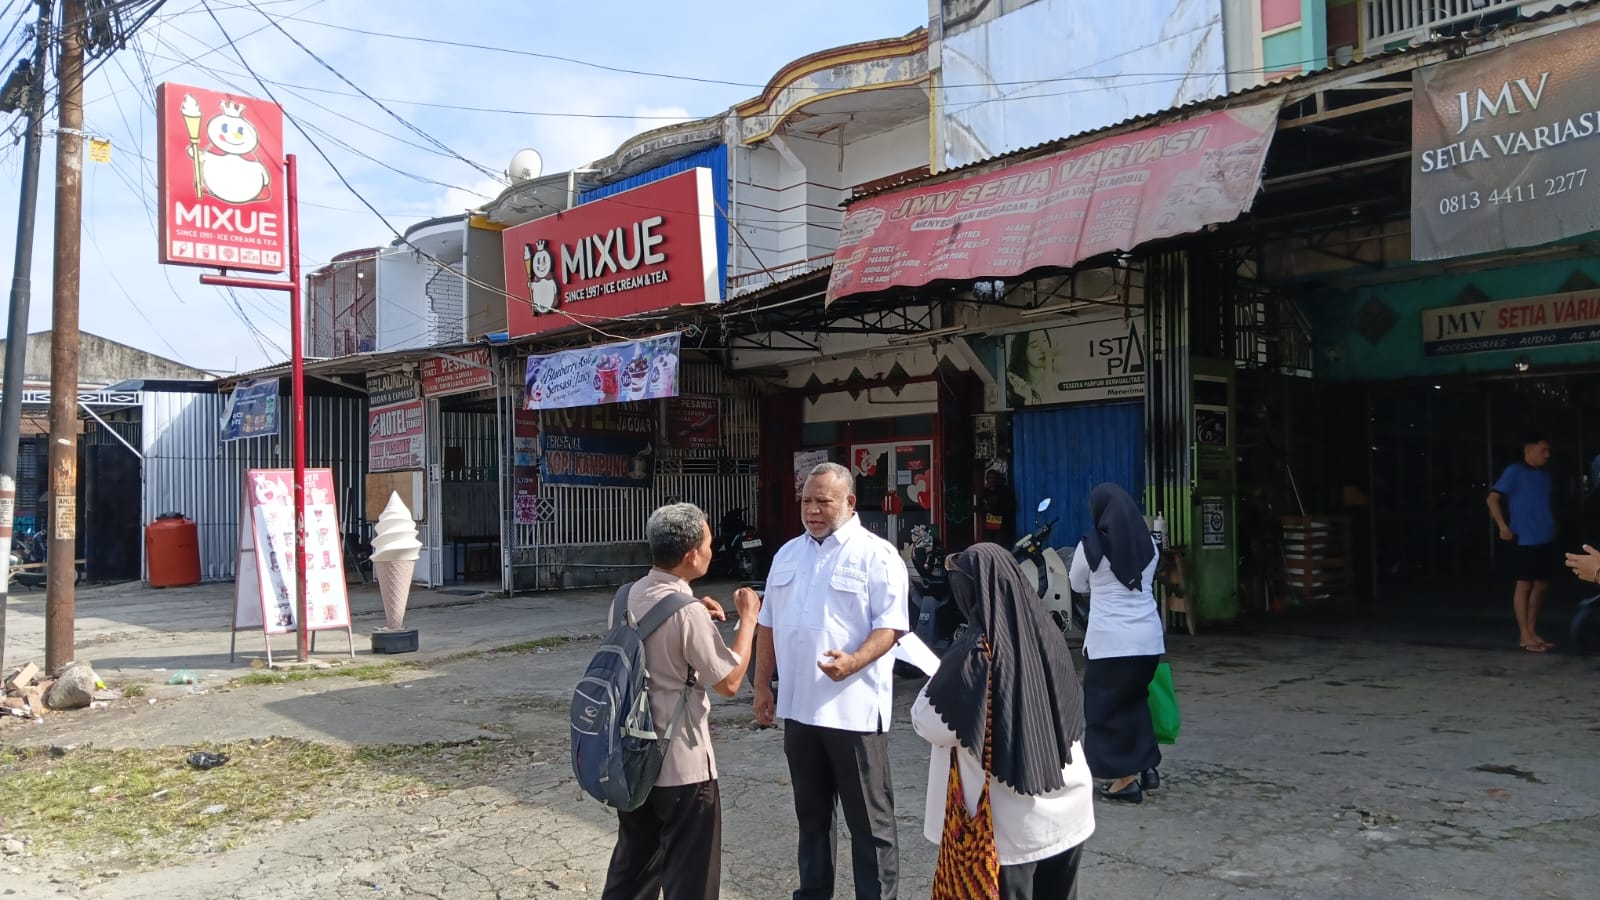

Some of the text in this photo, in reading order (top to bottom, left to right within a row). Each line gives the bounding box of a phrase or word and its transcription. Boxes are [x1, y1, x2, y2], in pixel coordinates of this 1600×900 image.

[1456, 71, 1549, 135] JMV
[1421, 139, 1491, 172] SETIA
[889, 124, 1212, 221] JMV SETIA VARIASI
[1109, 173, 1144, 187] MOBIL
[1440, 169, 1587, 214] 0813 4411 2277
[175, 201, 277, 237] MIXUE
[176, 229, 197, 238] SINCE
[200, 231, 213, 239] 1997
[230, 235, 255, 244] CREAM
[560, 215, 666, 285] MIXUE
[565, 290, 585, 303] SINCE
[603, 281, 616, 295] ICE
[617, 278, 643, 292] CREAM
[1436, 310, 1486, 339] JMV
[1497, 303, 1546, 330] SETIA
[1437, 338, 1507, 352] ACCESSORIES
[1519, 334, 1556, 346] AUDIO
[1570, 330, 1585, 340] AC
[378, 371, 414, 392] LAUNDRY
[380, 409, 407, 437] HOTEL
[545, 450, 629, 476] KOPI KAMPUNG
